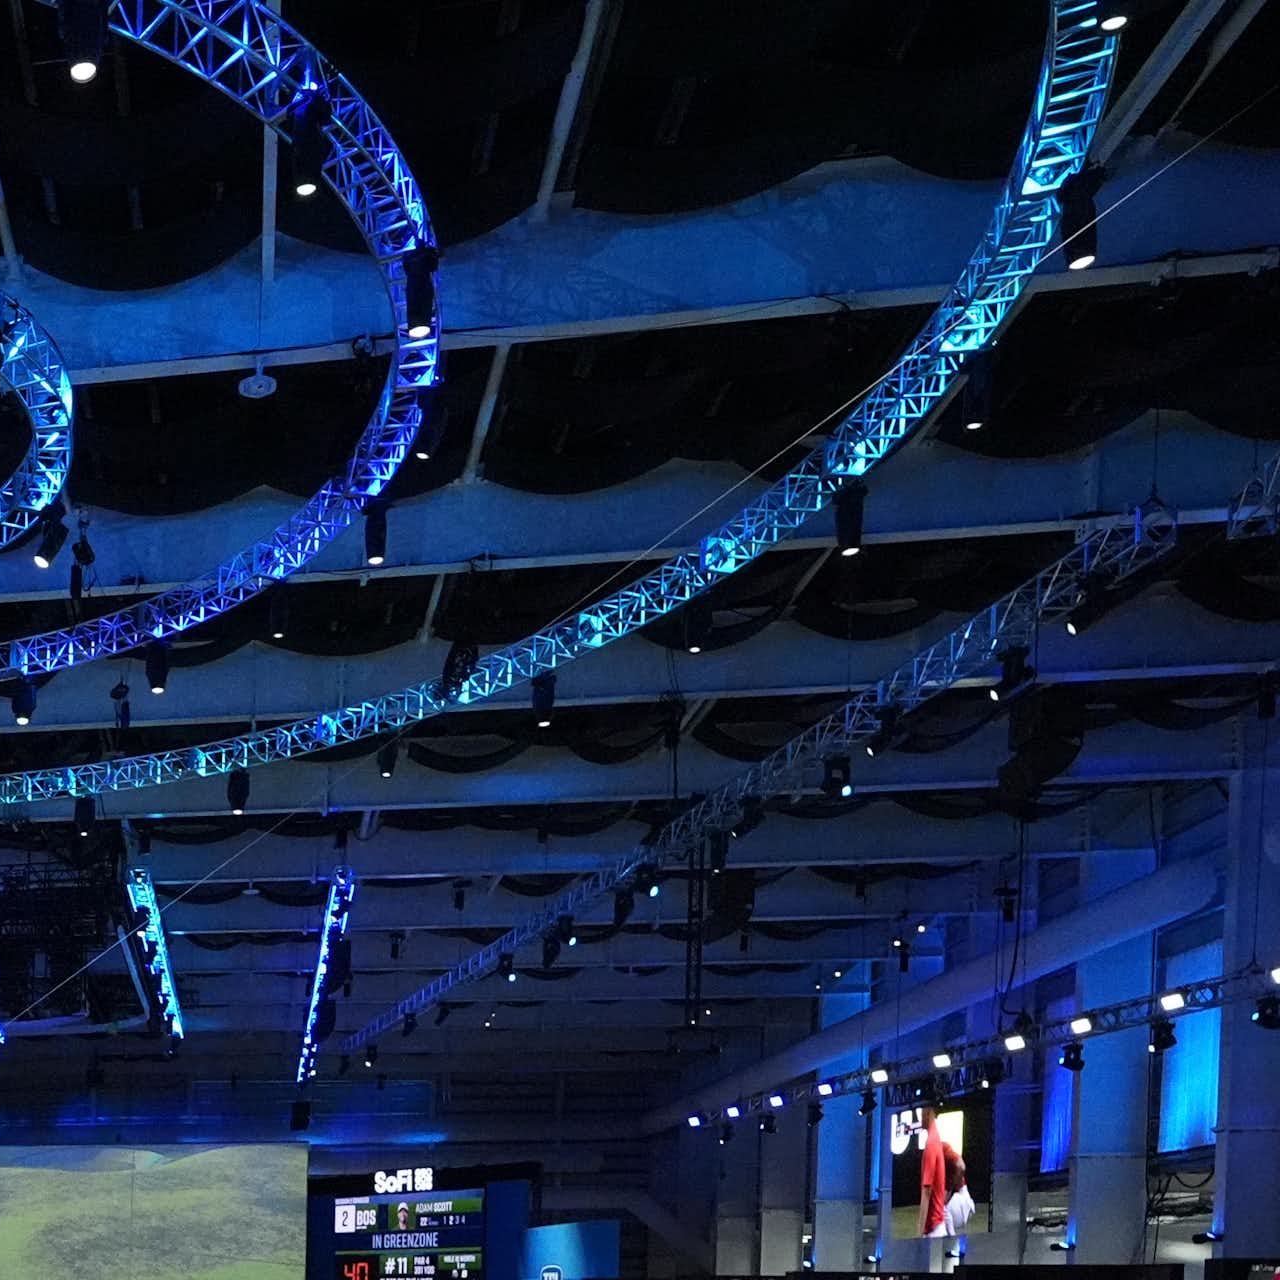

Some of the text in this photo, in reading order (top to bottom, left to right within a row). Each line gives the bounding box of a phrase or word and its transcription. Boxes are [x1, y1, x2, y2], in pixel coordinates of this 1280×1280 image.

[374, 1169, 412, 1193] SoFi
[433, 1202, 452, 1212] SCOTT
[342, 1210, 376, 1227] 2 BOS
[372, 1232, 438, 1248] IN GREENZONE
[385, 1257, 407, 1274] #11
